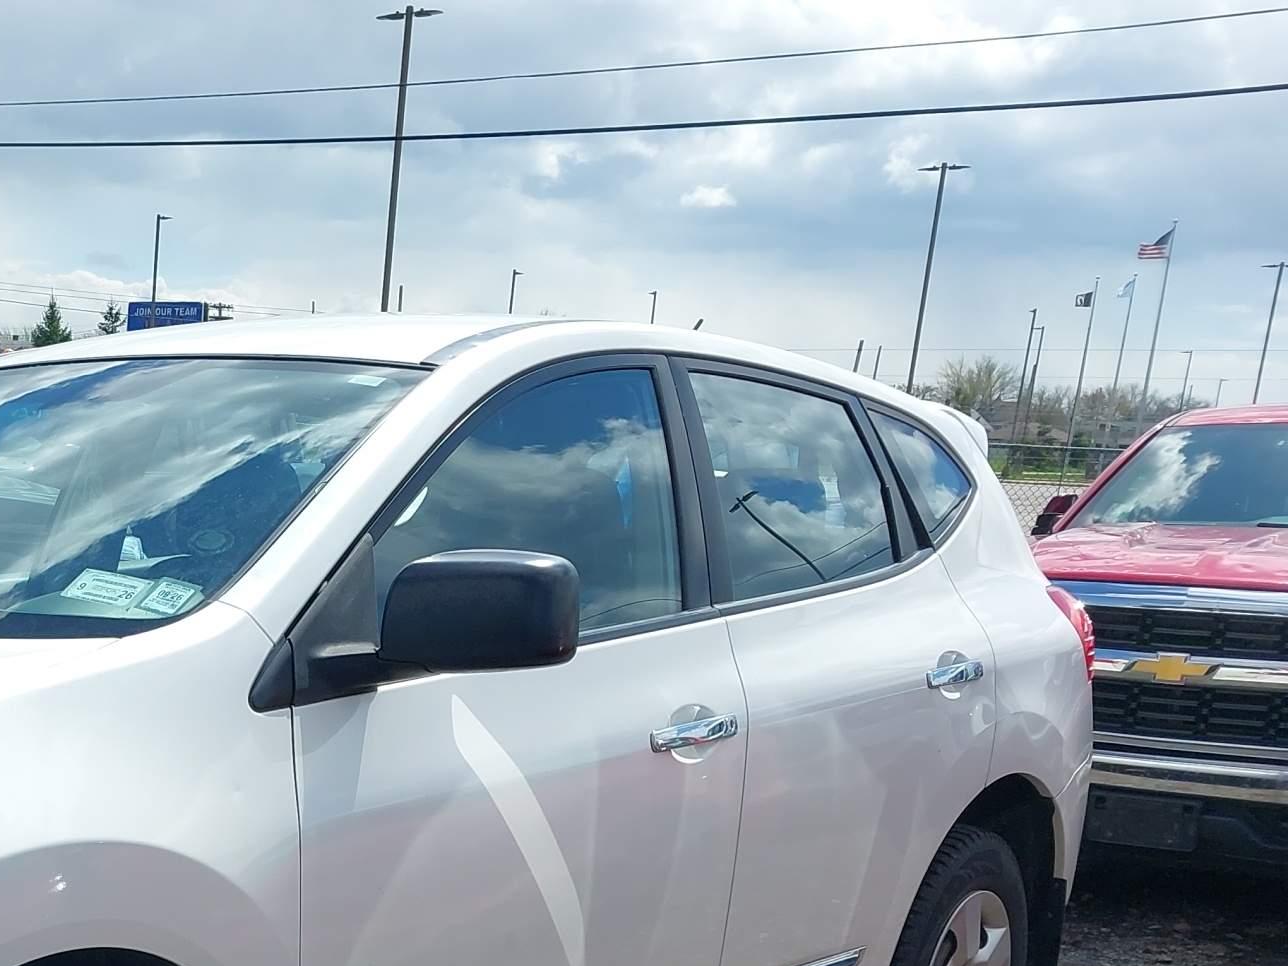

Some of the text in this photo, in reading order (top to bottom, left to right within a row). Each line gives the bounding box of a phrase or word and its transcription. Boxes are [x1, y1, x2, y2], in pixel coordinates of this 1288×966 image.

[135, 307, 197, 316] JOIN OUR TEAM
[118, 590, 136, 600] 26
